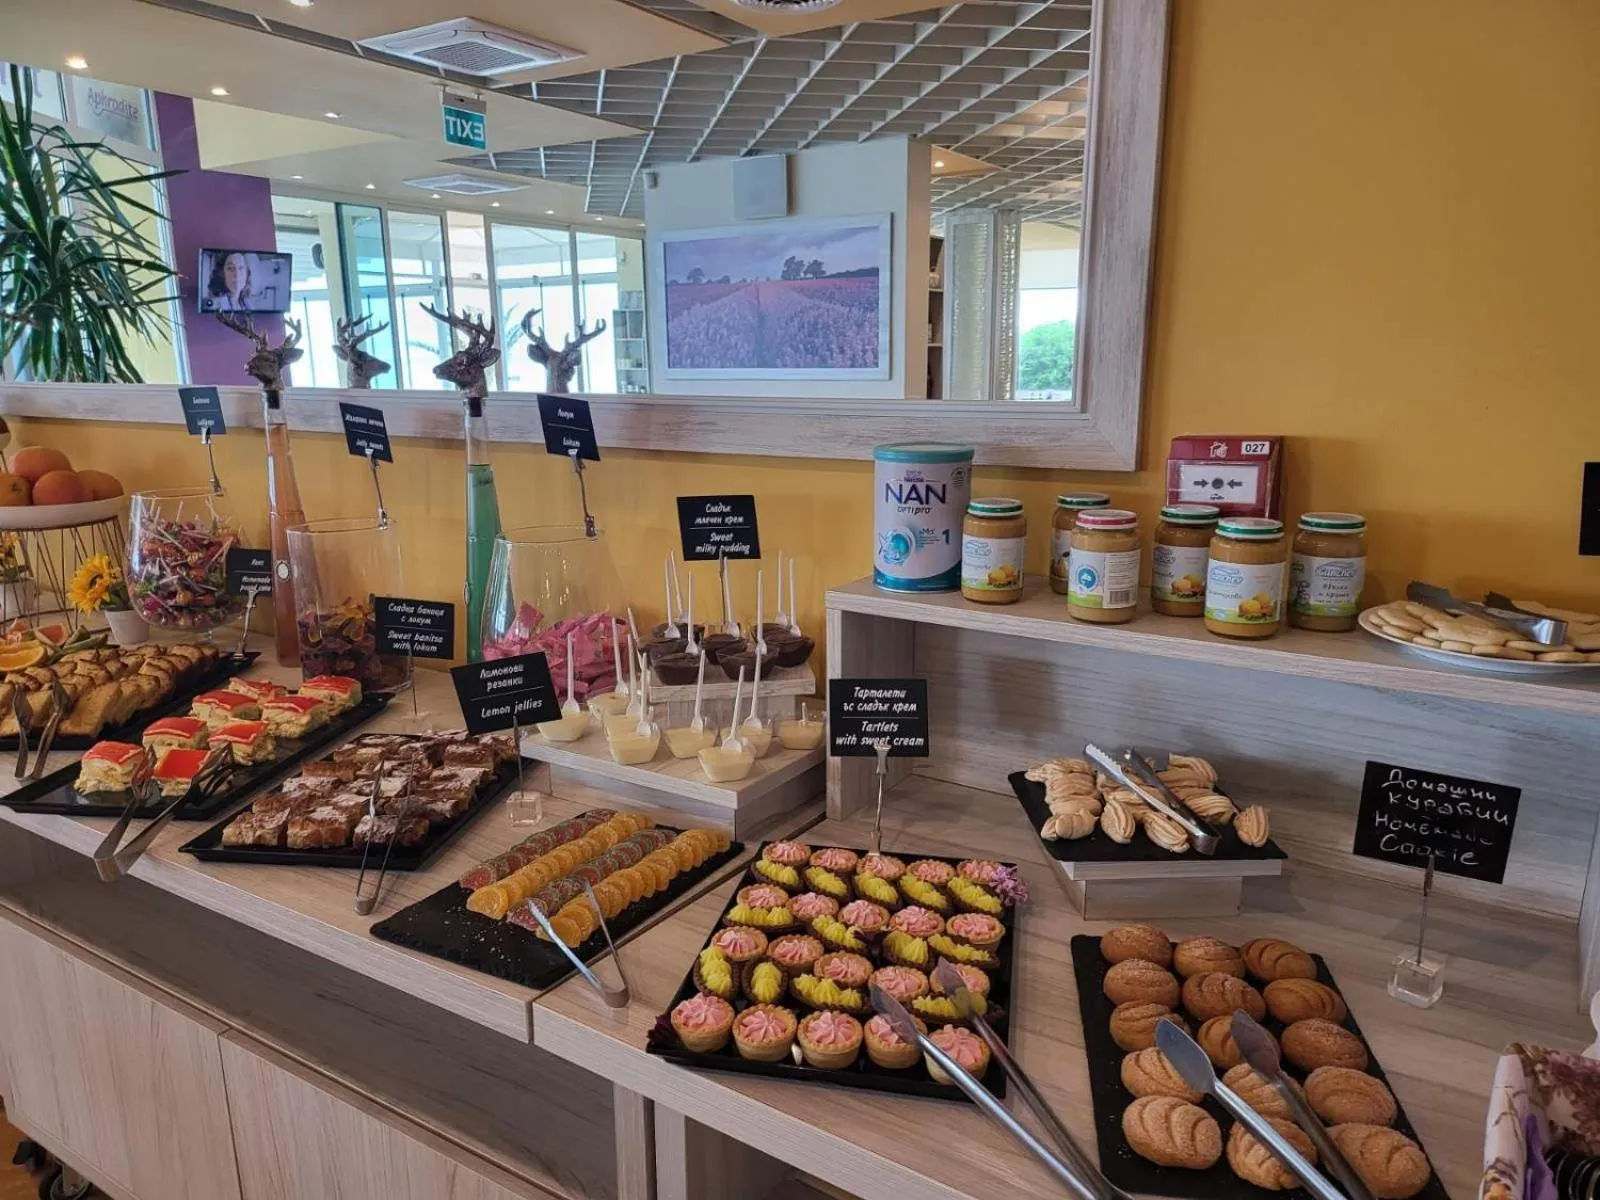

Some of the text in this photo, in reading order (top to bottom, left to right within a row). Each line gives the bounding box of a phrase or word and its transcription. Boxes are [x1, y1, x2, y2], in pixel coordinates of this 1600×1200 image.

[1245, 443, 1266, 453] 027
[885, 482, 947, 505] NAN
[710, 532, 734, 542] Sweet
[942, 528, 951, 545] 1
[695, 542, 751, 555] milky pudding
[387, 630, 412, 640] Sweet
[393, 641, 438, 652] with lokum
[486, 676, 524, 692] резанки
[853, 686, 907, 700] Тарталети
[481, 698, 543, 718] Lemon jellies
[857, 699, 890, 712] сладък
[892, 703, 917, 714] крем
[861, 720, 899, 732] Tartlets
[836, 733, 925, 747] with sweet cream
